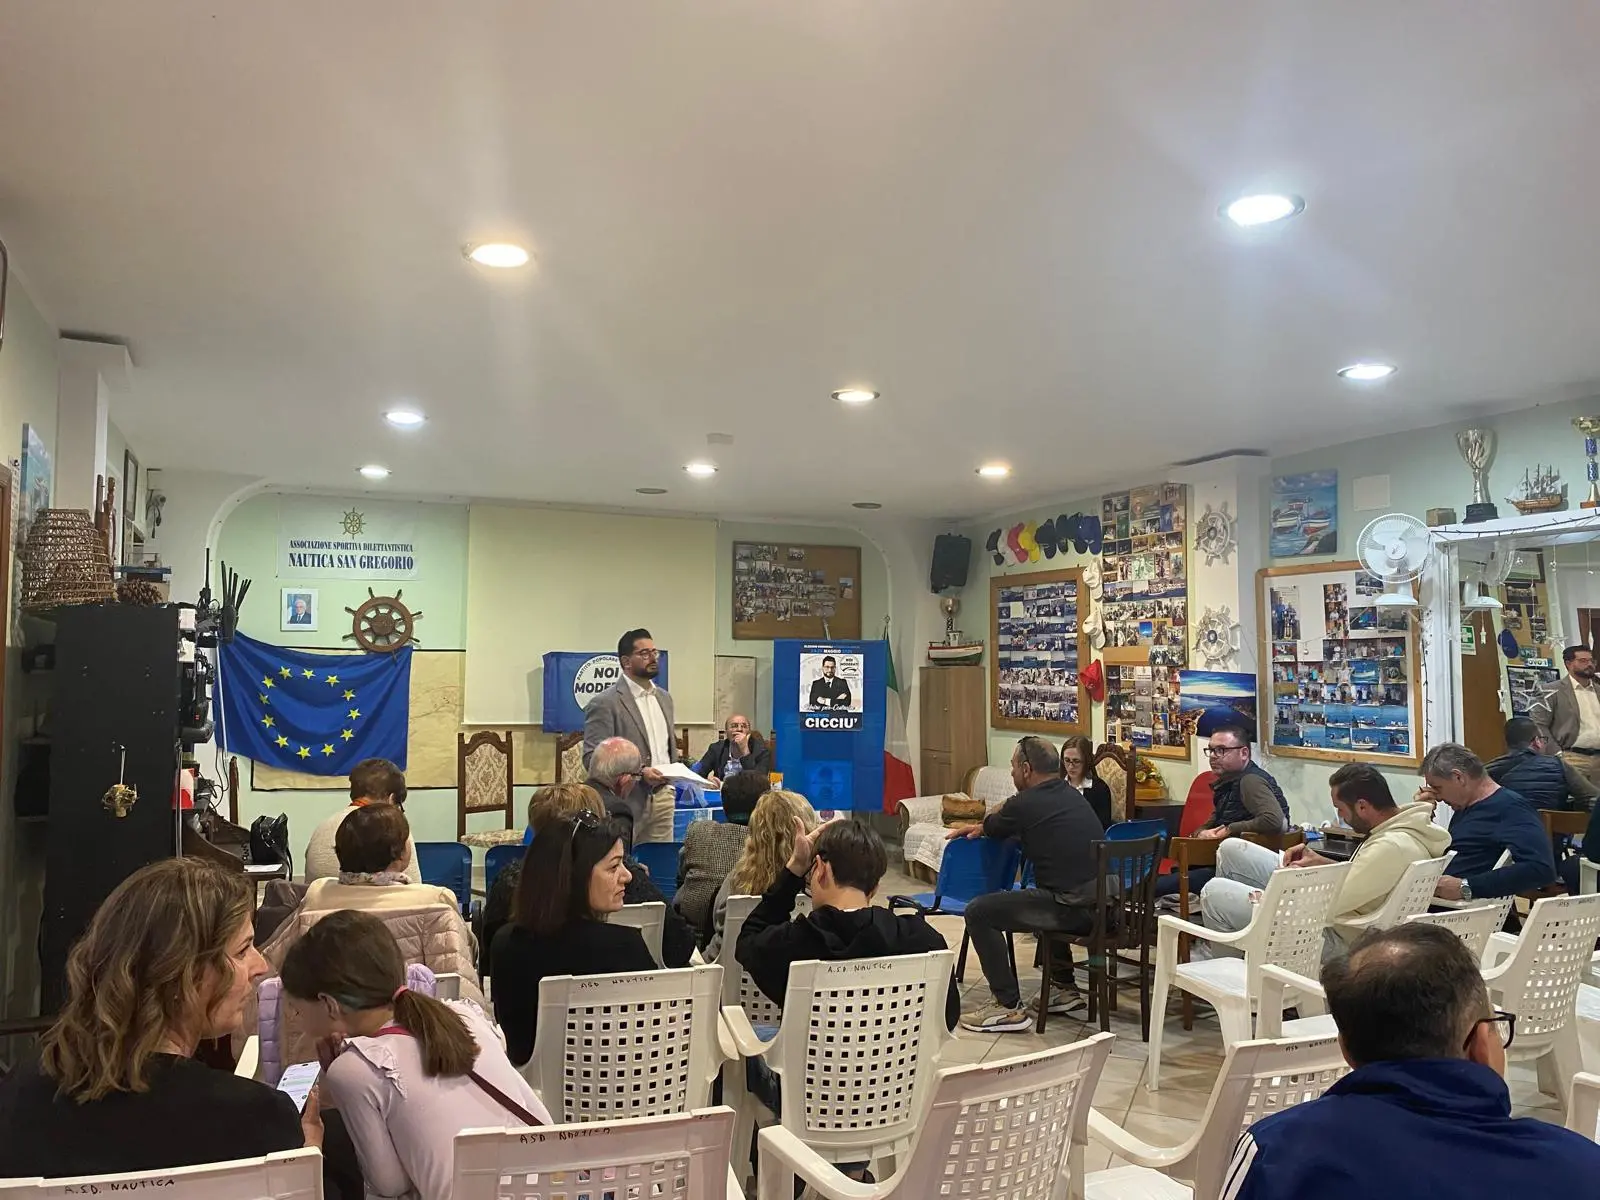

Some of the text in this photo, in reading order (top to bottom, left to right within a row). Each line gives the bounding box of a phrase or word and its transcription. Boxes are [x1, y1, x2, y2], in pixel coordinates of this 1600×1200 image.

[289, 540, 413, 553] ASSOCIAZIONE SPORTIVA DILETTANTISTICA
[288, 553, 414, 570] NAUTICA SAN GREGORIO
[577, 662, 591, 680] PARTITO
[594, 667, 619, 678] NOI
[575, 682, 615, 693] MODE
[805, 717, 858, 729] CICCIU'
[854, 963, 893, 973] NAUTICA
[612, 976, 654, 985] NAUTICA
[110, 1178, 176, 1192] NAUTICA
